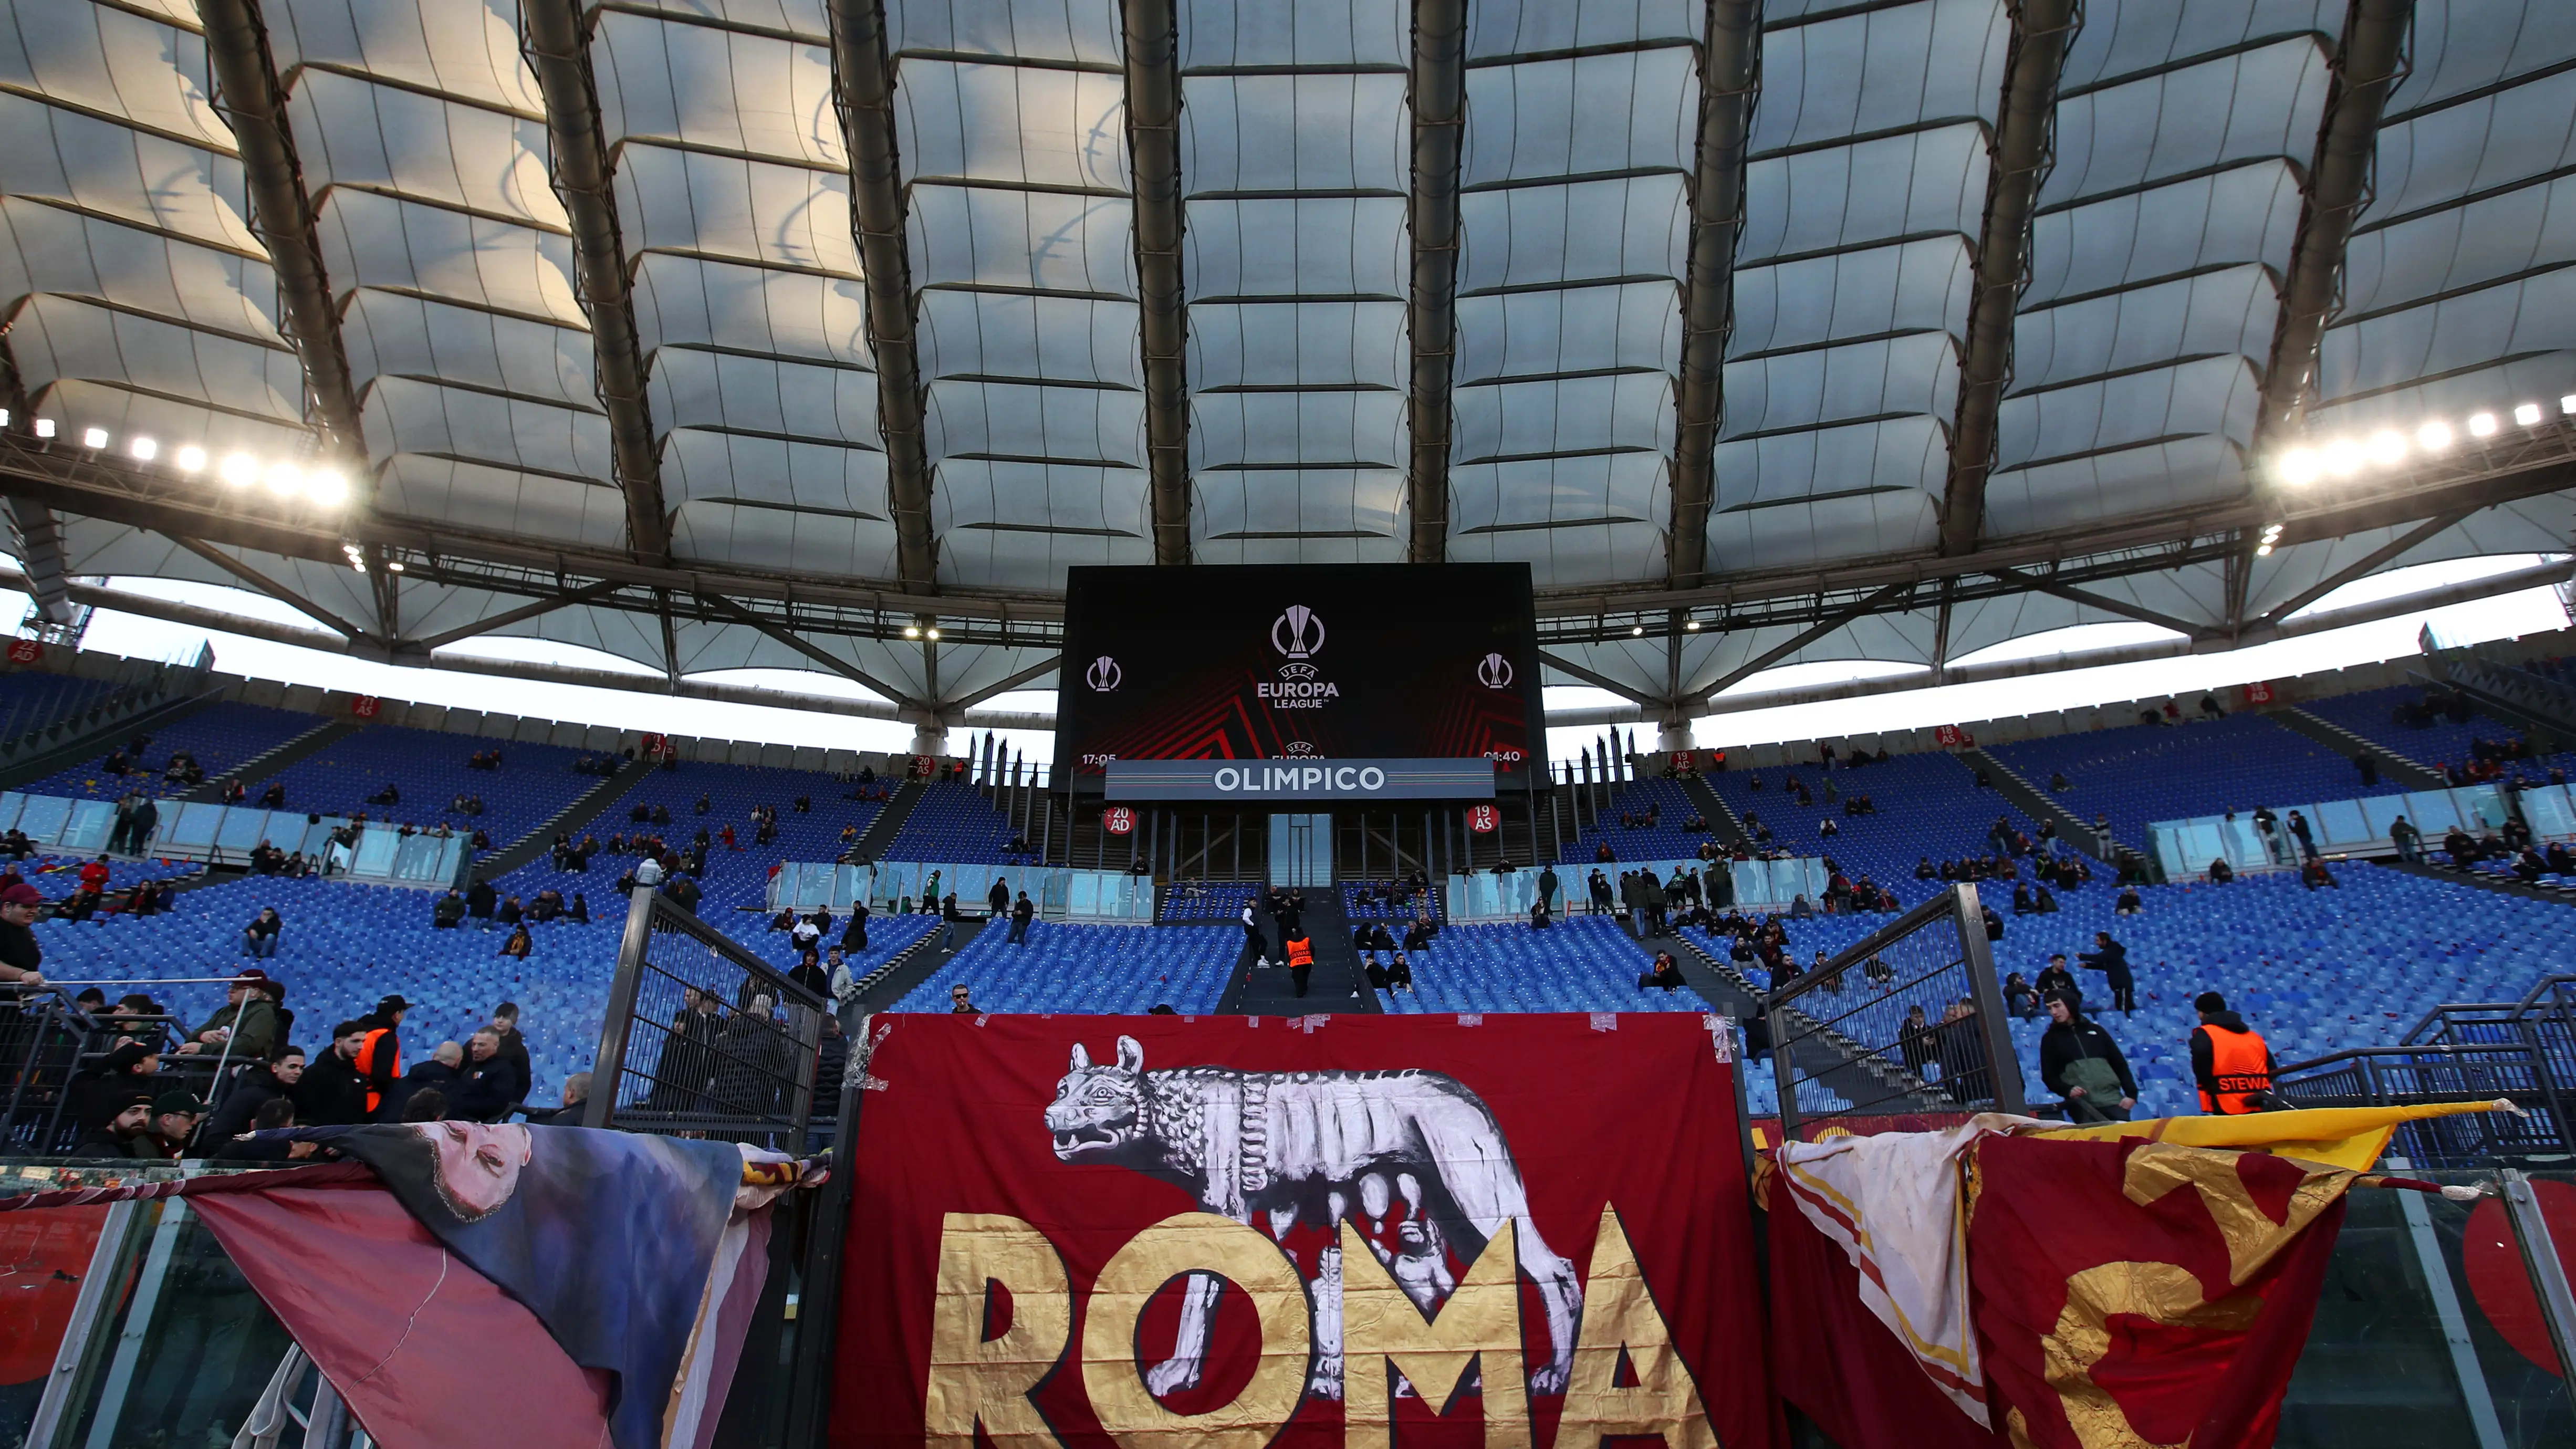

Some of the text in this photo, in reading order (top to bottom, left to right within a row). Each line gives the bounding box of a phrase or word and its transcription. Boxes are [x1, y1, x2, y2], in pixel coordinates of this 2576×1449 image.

[11, 650, 35, 661] AD
[1280, 666, 1315, 677] UEFA
[1258, 682, 1339, 697] EUROPA
[1274, 700, 1322, 708] LEAGUE
[1939, 726, 1953, 735] 18
[1943, 735, 1956, 744] AS
[1287, 744, 1311, 752] UEFA
[919, 757, 930, 765] 20
[1677, 752, 1687, 760] 19
[917, 766, 929, 774] AS
[1214, 767, 1385, 791] OLIMPICO
[1113, 807, 1129, 818] 20
[1475, 805, 1490, 817] 19
[1110, 819, 1130, 831] AD
[1475, 817, 1493, 830] AS
[924, 1201, 1724, 1449] ROMA
